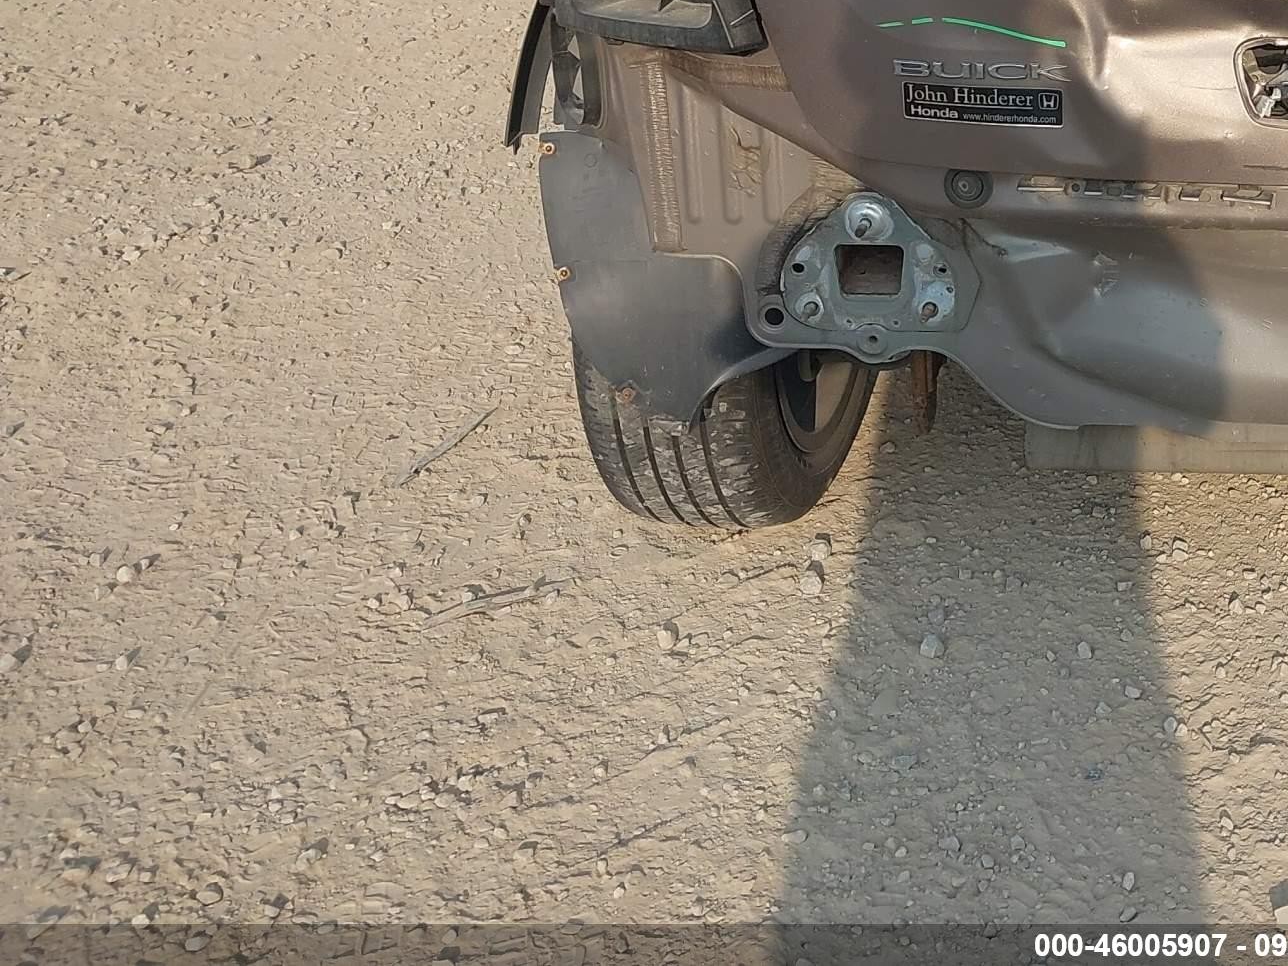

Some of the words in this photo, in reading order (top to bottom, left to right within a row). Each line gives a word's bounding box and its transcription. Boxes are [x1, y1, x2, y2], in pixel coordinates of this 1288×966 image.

[893, 59, 1072, 82] BUICK
[906, 83, 947, 103] John
[953, 87, 1033, 106] Hinderer
[910, 105, 958, 119] Honda
[962, 112, 1057, 124] www.hindererhonda.com
